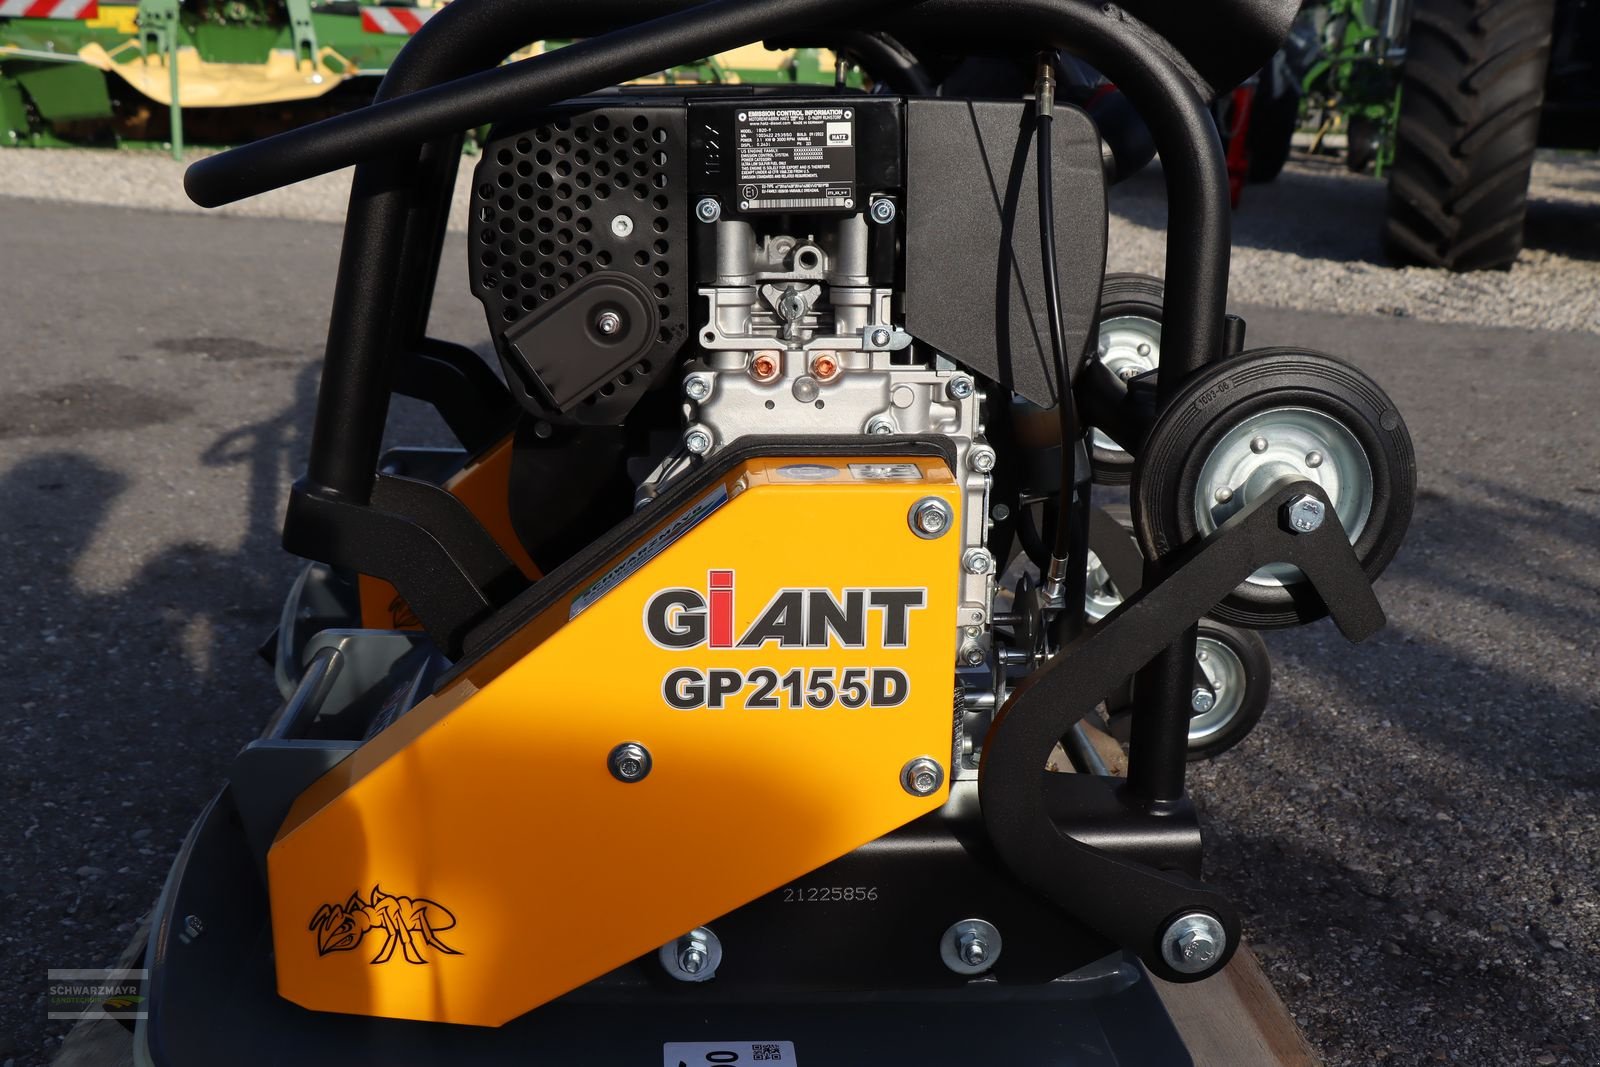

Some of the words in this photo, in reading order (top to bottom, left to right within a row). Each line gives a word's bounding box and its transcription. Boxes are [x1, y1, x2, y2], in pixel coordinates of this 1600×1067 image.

[582, 505, 703, 598] SCHWARZMAYR
[662, 667, 910, 710] GP2155D
[784, 886, 878, 902] 21225856
